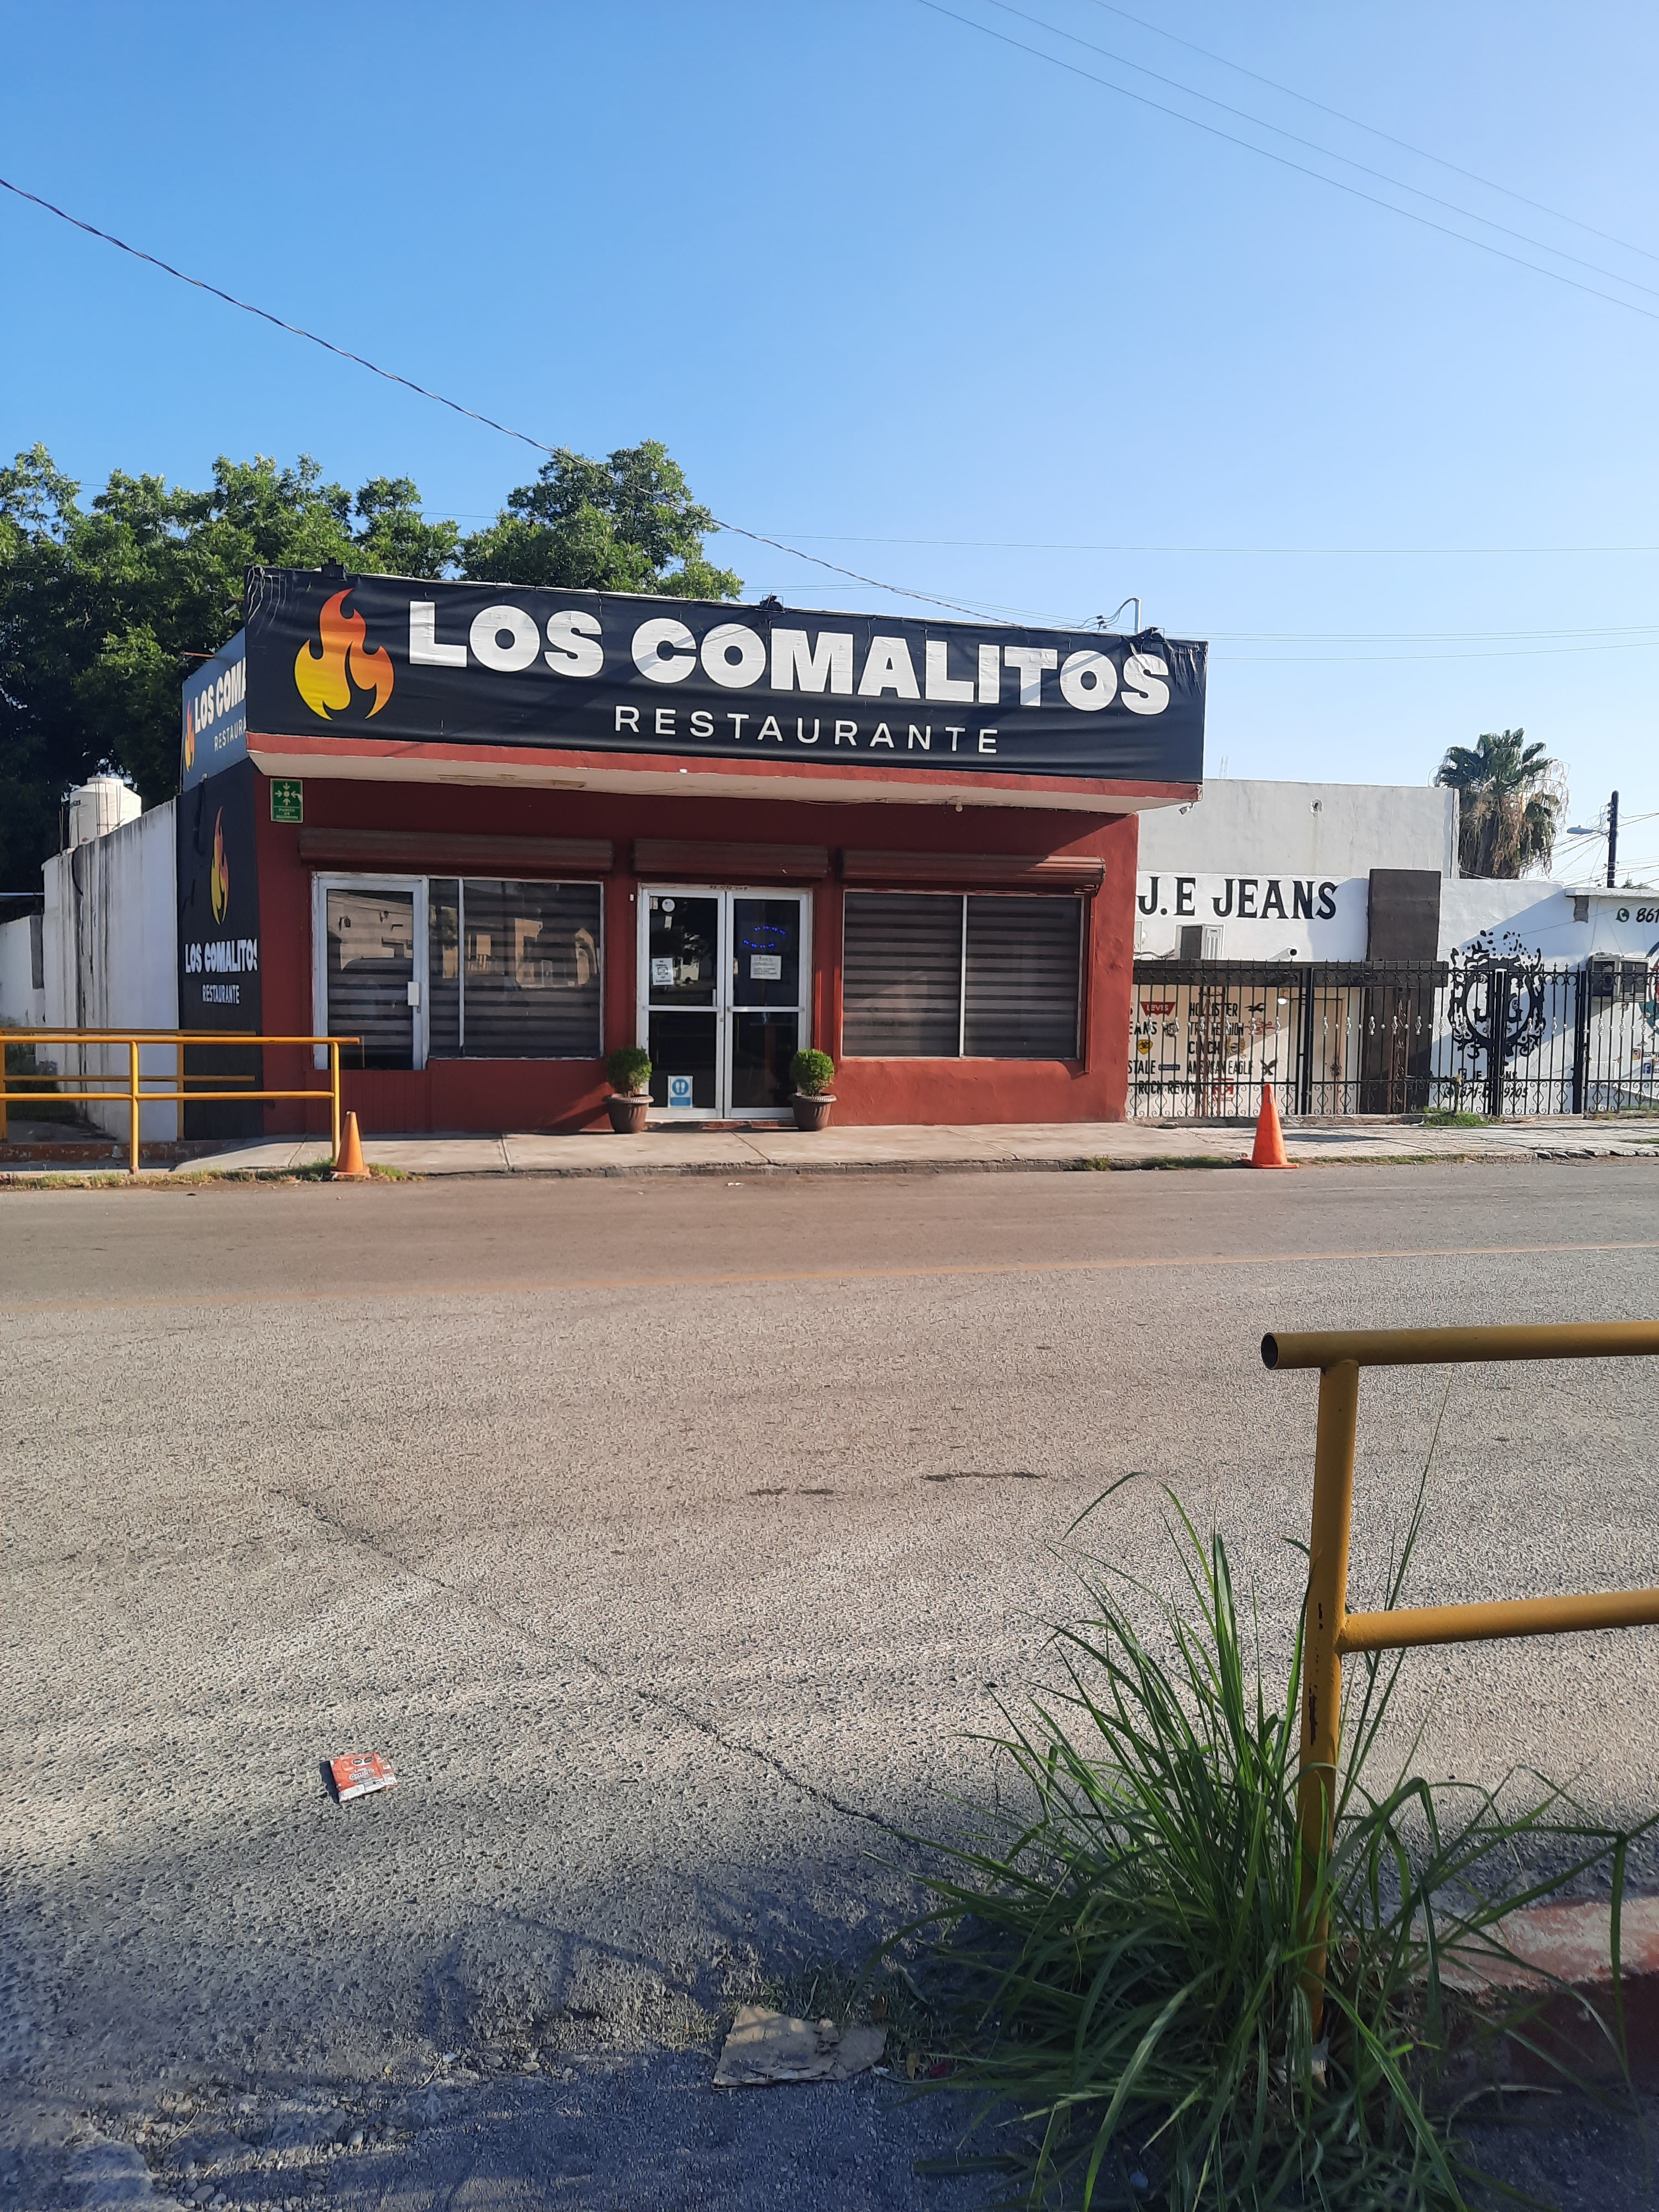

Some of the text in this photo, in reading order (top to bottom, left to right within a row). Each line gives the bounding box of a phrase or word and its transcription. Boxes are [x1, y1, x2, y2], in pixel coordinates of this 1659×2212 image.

[409, 600, 1170, 715] LOS COMALITOS
[195, 684, 214, 734] LOS
[614, 705, 998, 754] RESTAURANTE
[1136, 877, 1338, 919] J.E JEANS
[185, 942, 202, 973] LOS
[202, 984, 240, 1004] RESTAURANTE
[1188, 1002, 1238, 1017] HOISTER
